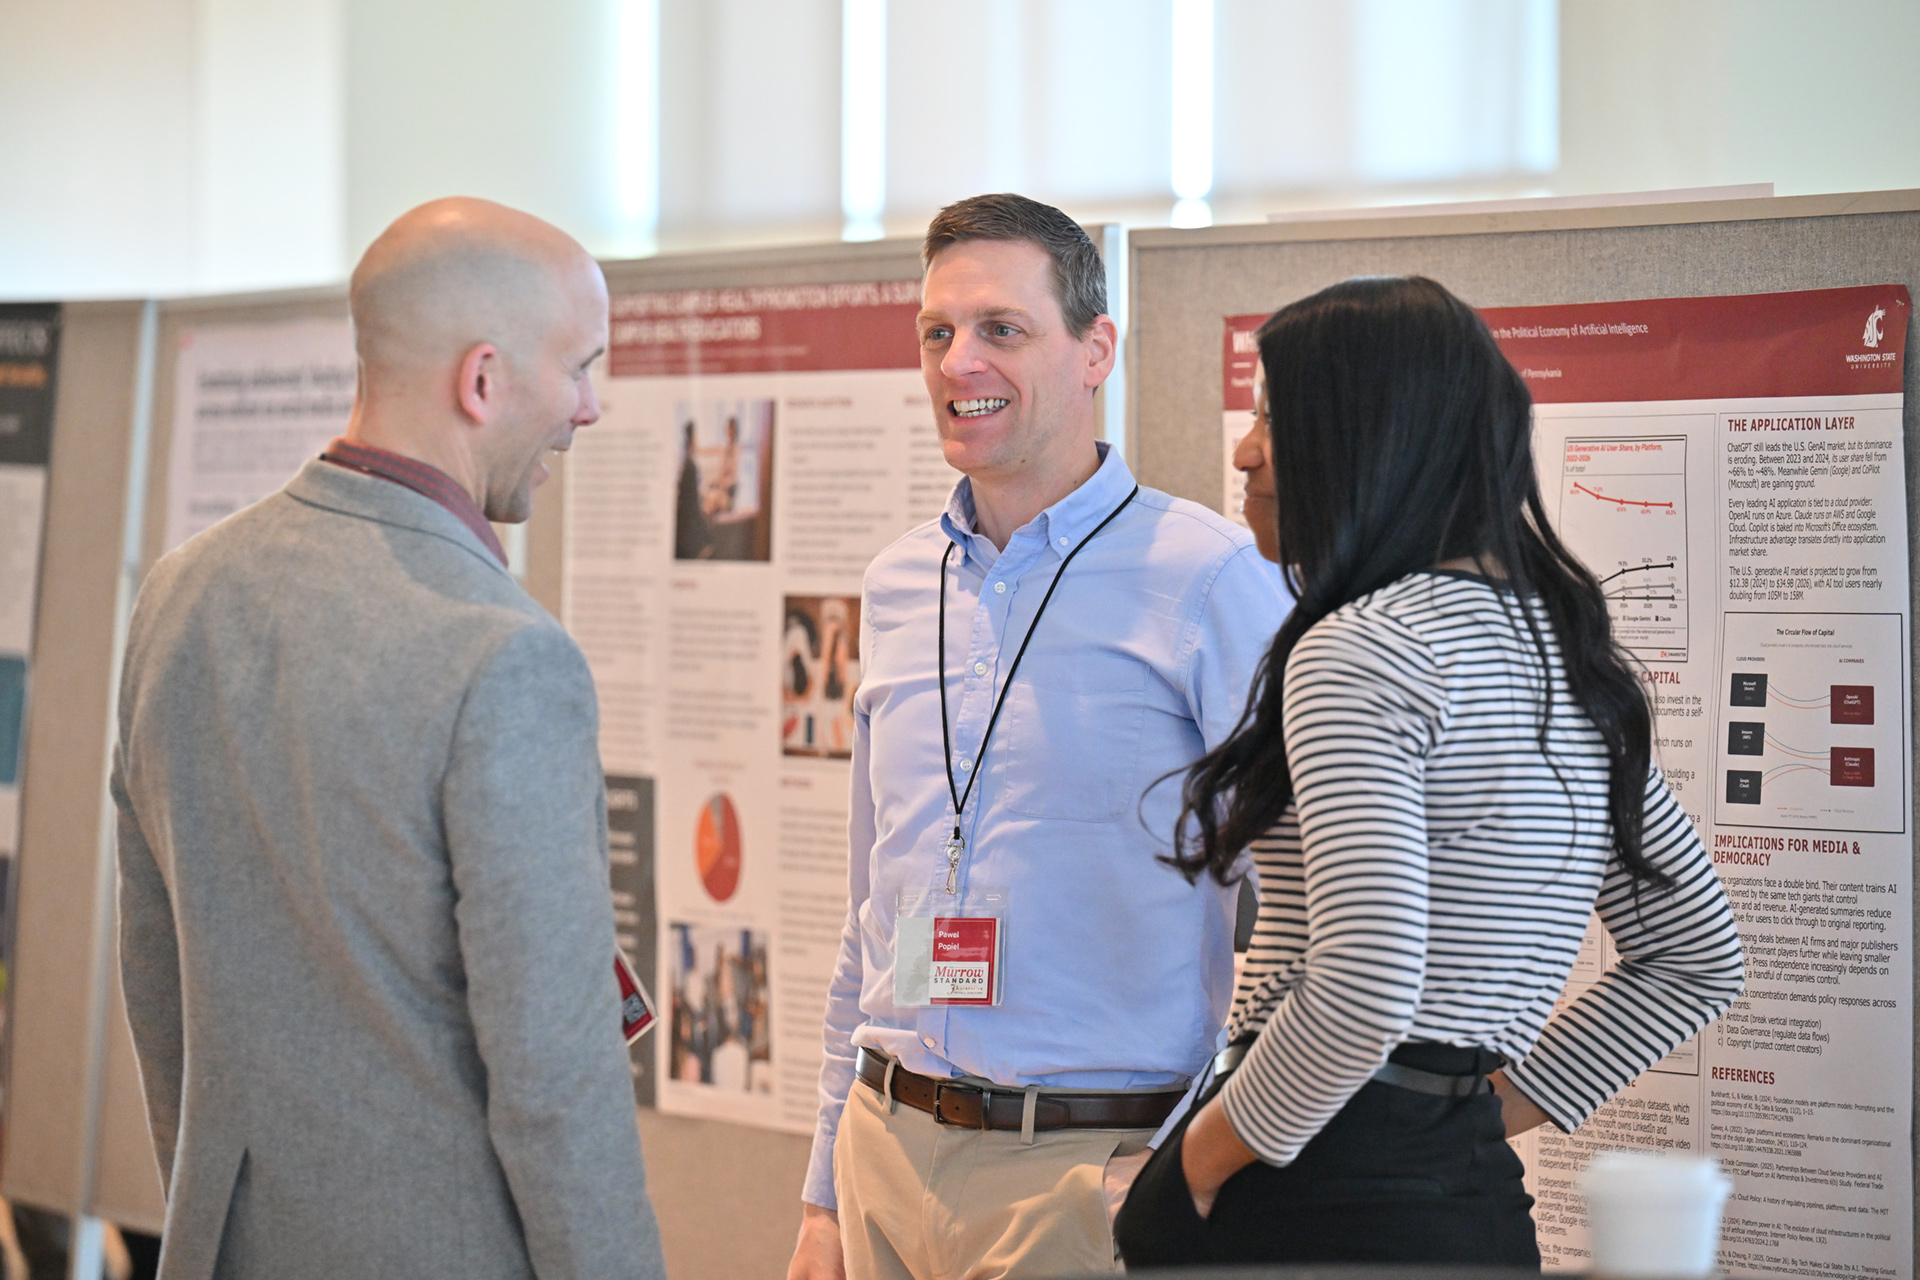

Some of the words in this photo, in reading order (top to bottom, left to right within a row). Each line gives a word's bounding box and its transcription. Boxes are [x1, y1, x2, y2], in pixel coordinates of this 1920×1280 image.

[1500, 328, 1512, 338] the
[1512, 327, 1538, 338] Political
[1539, 327, 1570, 339] Economy
[1571, 325, 1578, 336] of
[1579, 324, 1608, 336] Artificial
[1609, 324, 1648, 337] Intelligence
[1846, 354, 1880, 362] WASHINGTON
[1882, 353, 1896, 361] STATE
[1728, 419, 1747, 431] THE
[1750, 418, 1820, 431] APPLICATION
[1826, 417, 1854, 430] LAYER
[1727, 442, 1752, 452] ChatGPT
[1754, 442, 1764, 451] still
[1765, 441, 1780, 451] leads
[1782, 441, 1792, 451] the
[1793, 441, 1806, 451] U.S.
[1808, 441, 1825, 450] GenAI
[1827, 440, 1846, 451] market,
[1848, 440, 1856, 450] but
[1864, 440, 1892, 450] dominance
[1728, 454, 1732, 464] is
[1734, 454, 1757, 466] eroding.
[1759, 454, 1784, 463] Between
[1786, 453, 1801, 463] 2023
[1803, 453, 1813, 463] and
[1815, 453, 1830, 464] 2024,
[1850, 452, 1864, 462] share
[1865, 452, 1873, 462] fell
[1874, 452, 1887, 461] from
[1748, 467, 1754, 476] to
[1778, 465, 1808, 475] Meanwhile
[1810, 465, 1828, 475] Gemini
[1830, 465, 1850, 477] (Google)
[1852, 465, 1861, 474] and
[1862, 464, 1880, 474] CoPilot
[1728, 479, 1759, 490] (Microsoft)
[1772, 478, 1793, 490] gaining
[1795, 478, 1815, 490] ground.
[1729, 498, 1744, 510] Every
[1746, 498, 1767, 509] leading
[1769, 498, 1775, 507] AI
[1777, 498, 1806, 509] application
[1808, 497, 1812, 507] is
[1813, 497, 1823, 507] tied
[1824, 498, 1829, 507] to
[1835, 497, 1848, 507] cloud
[1849, 497, 1872, 509] provider:
[1729, 510, 1750, 522] OpenAI
[1776, 510, 1793, 519] Azure.
[1794, 510, 1812, 519] Claude
[1833, 509, 1844, 519] AWS
[1846, 509, 1855, 519] and
[1856, 509, 1876, 521] Google
[1729, 522, 1747, 532] Cloud.
[1749, 522, 1769, 534] Copilot
[1770, 522, 1775, 532] is
[1777, 522, 1793, 532] baked
[1794, 522, 1804, 531] into
[1805, 522, 1831, 531] Microsoft's
[1832, 522, 1846, 531] Office
[1848, 522, 1878, 533] ecosystem.
[1818, 629, 1834, 637] Capital
[1642, 671, 1681, 684] CAPITAL
[1715, 835, 1784, 850] IMPLICATIONS
[1788, 839, 1808, 852] FOR
[1813, 840, 1848, 854] MEDIA
[1853, 842, 1860, 854] &
[1714, 851, 1771, 866] DEMOCRACY
[1728, 877, 1763, 889] organizations
[1764, 878, 1776, 888] face
[1783, 879, 1804, 889] double
[1805, 880, 1820, 890] bind.
[1822, 880, 1837, 890] Their
[1839, 883, 1864, 892] content
[1865, 883, 1886, 893] trains
[1888, 883, 1897, 893] AI
[1731, 889, 1749, 898] owned
[1751, 889, 1757, 902] by
[1759, 890, 1769, 899] the
[1788, 891, 1801, 901] tech
[1802, 892, 1820, 904] giants
[1822, 893, 1834, 903] that
[1836, 894, 1858, 904] control
[1741, 901, 1752, 910] and
[1753, 901, 1761, 911] ad
[1762, 904, 1788, 912] revenue.
[1790, 903, 1828, 916] AI-generated
[1830, 906, 1864, 916] summaries
[1866, 907, 1891, 918] reduce
[1746, 912, 1754, 922] for
[1756, 915, 1771, 923] users
[1773, 915, 1779, 924] to
[1780, 914, 1794, 925] click
[1795, 915, 1819, 929] through
[1820, 918, 1827, 927] to
[1828, 918, 1851, 930] original
[1853, 920, 1886, 933] reporting.
[939, 930, 959, 938] Pawel
[938, 943, 959, 951] Popiel
[934, 966, 984, 977] Murrow
[1726, 1012, 1749, 1022] Antitrust
[1750, 1014, 1767, 1025] (break
[1768, 1016, 1787, 1025] vertical
[1789, 1017, 1821, 1031] integration)
[1718, 1024, 1724, 1035] b)
[1727, 1025, 1739, 1034] Data
[1740, 1026, 1770, 1036] Governance
[1772, 1028, 1796, 1040] (regulate
[1798, 1030, 1810, 1039] data
[1812, 1031, 1830, 1043] flows)
[1718, 1037, 1724, 1048] c)
[1727, 1037, 1751, 1050] Copyright
[1753, 1039, 1773, 1051] (protect
[1775, 1043, 1795, 1051] content
[1796, 1045, 1822, 1056] creators)
[1712, 1067, 1775, 1084] REFERENCES
[1615, 1097, 1646, 1111] high-quality
[1647, 1100, 1672, 1112] datasets,
[1673, 1102, 1689, 1113] which
[1599, 1106, 1617, 1119] Google
[1618, 1110, 1639, 1119] controls
[1640, 1112, 1658, 1121] search
[1659, 1113, 1674, 1125] data;
[1675, 1115, 1689, 1125] Meta
